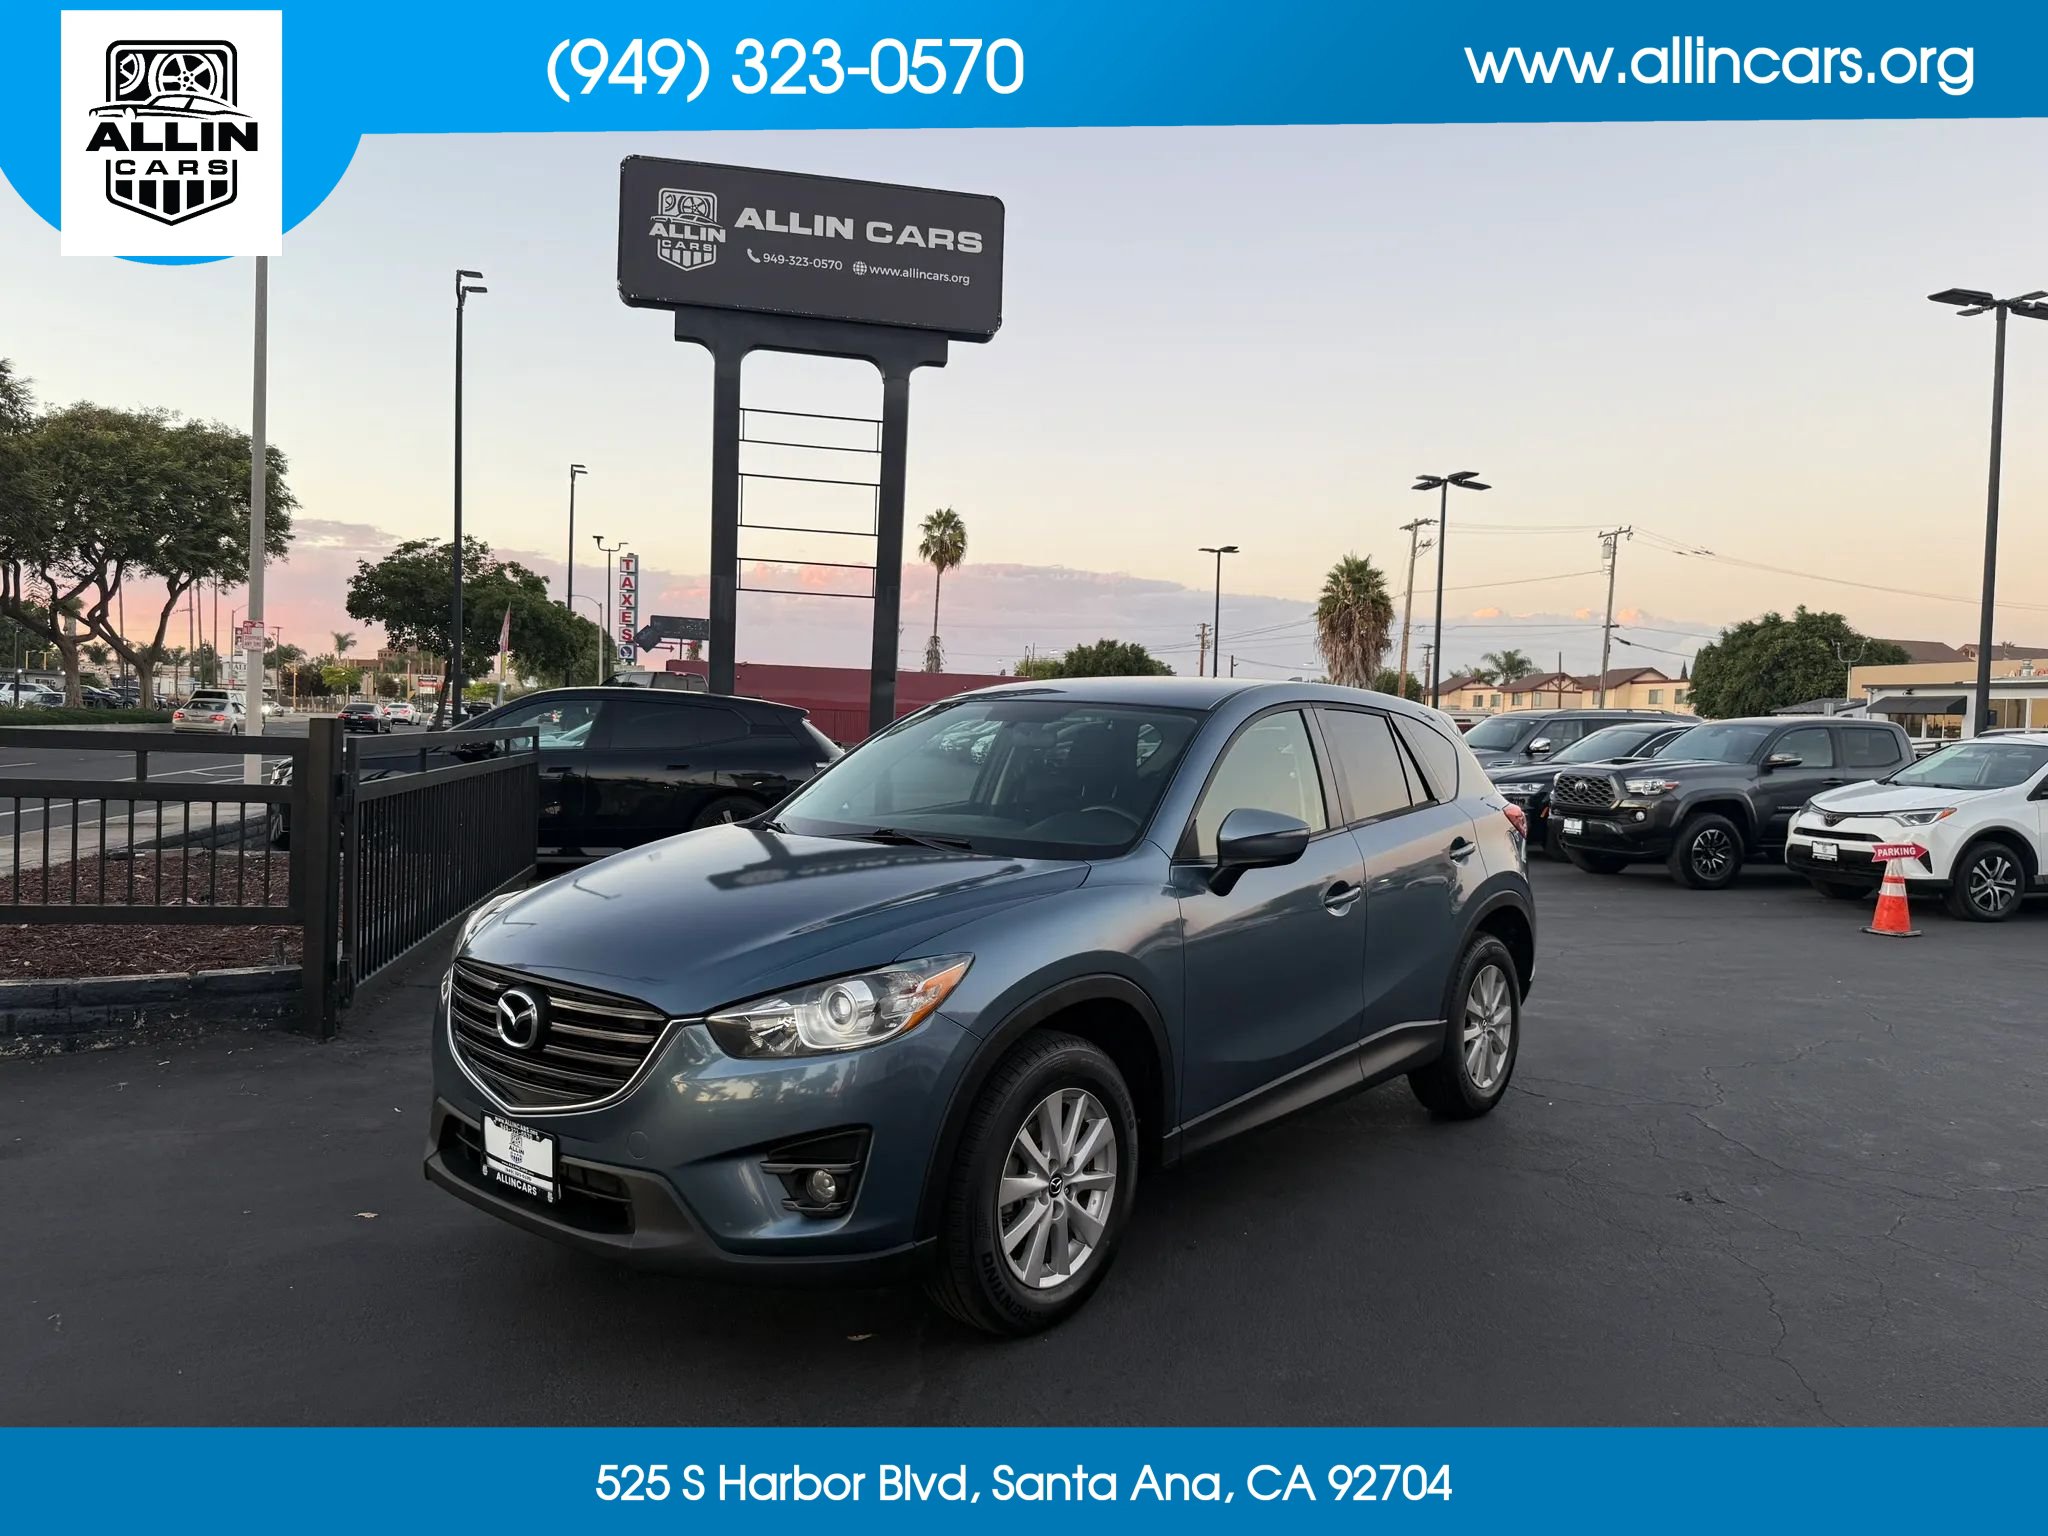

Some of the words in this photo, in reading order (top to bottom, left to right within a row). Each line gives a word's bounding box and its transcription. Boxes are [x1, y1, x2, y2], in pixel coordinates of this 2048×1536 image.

[648, 222, 726, 243] ALLIN
[734, 207, 853, 240] ALLIN
[865, 221, 983, 254] CARS
[661, 239, 713, 252] CARS
[763, 252, 843, 271] 949-323-0570
[869, 264, 970, 286] www.allincars.org
[621, 559, 634, 641] TAXES
[1877, 846, 1916, 858] PARKING
[508, 1145, 525, 1155] ALLIN
[495, 1171, 538, 1196] ALLINCARS
